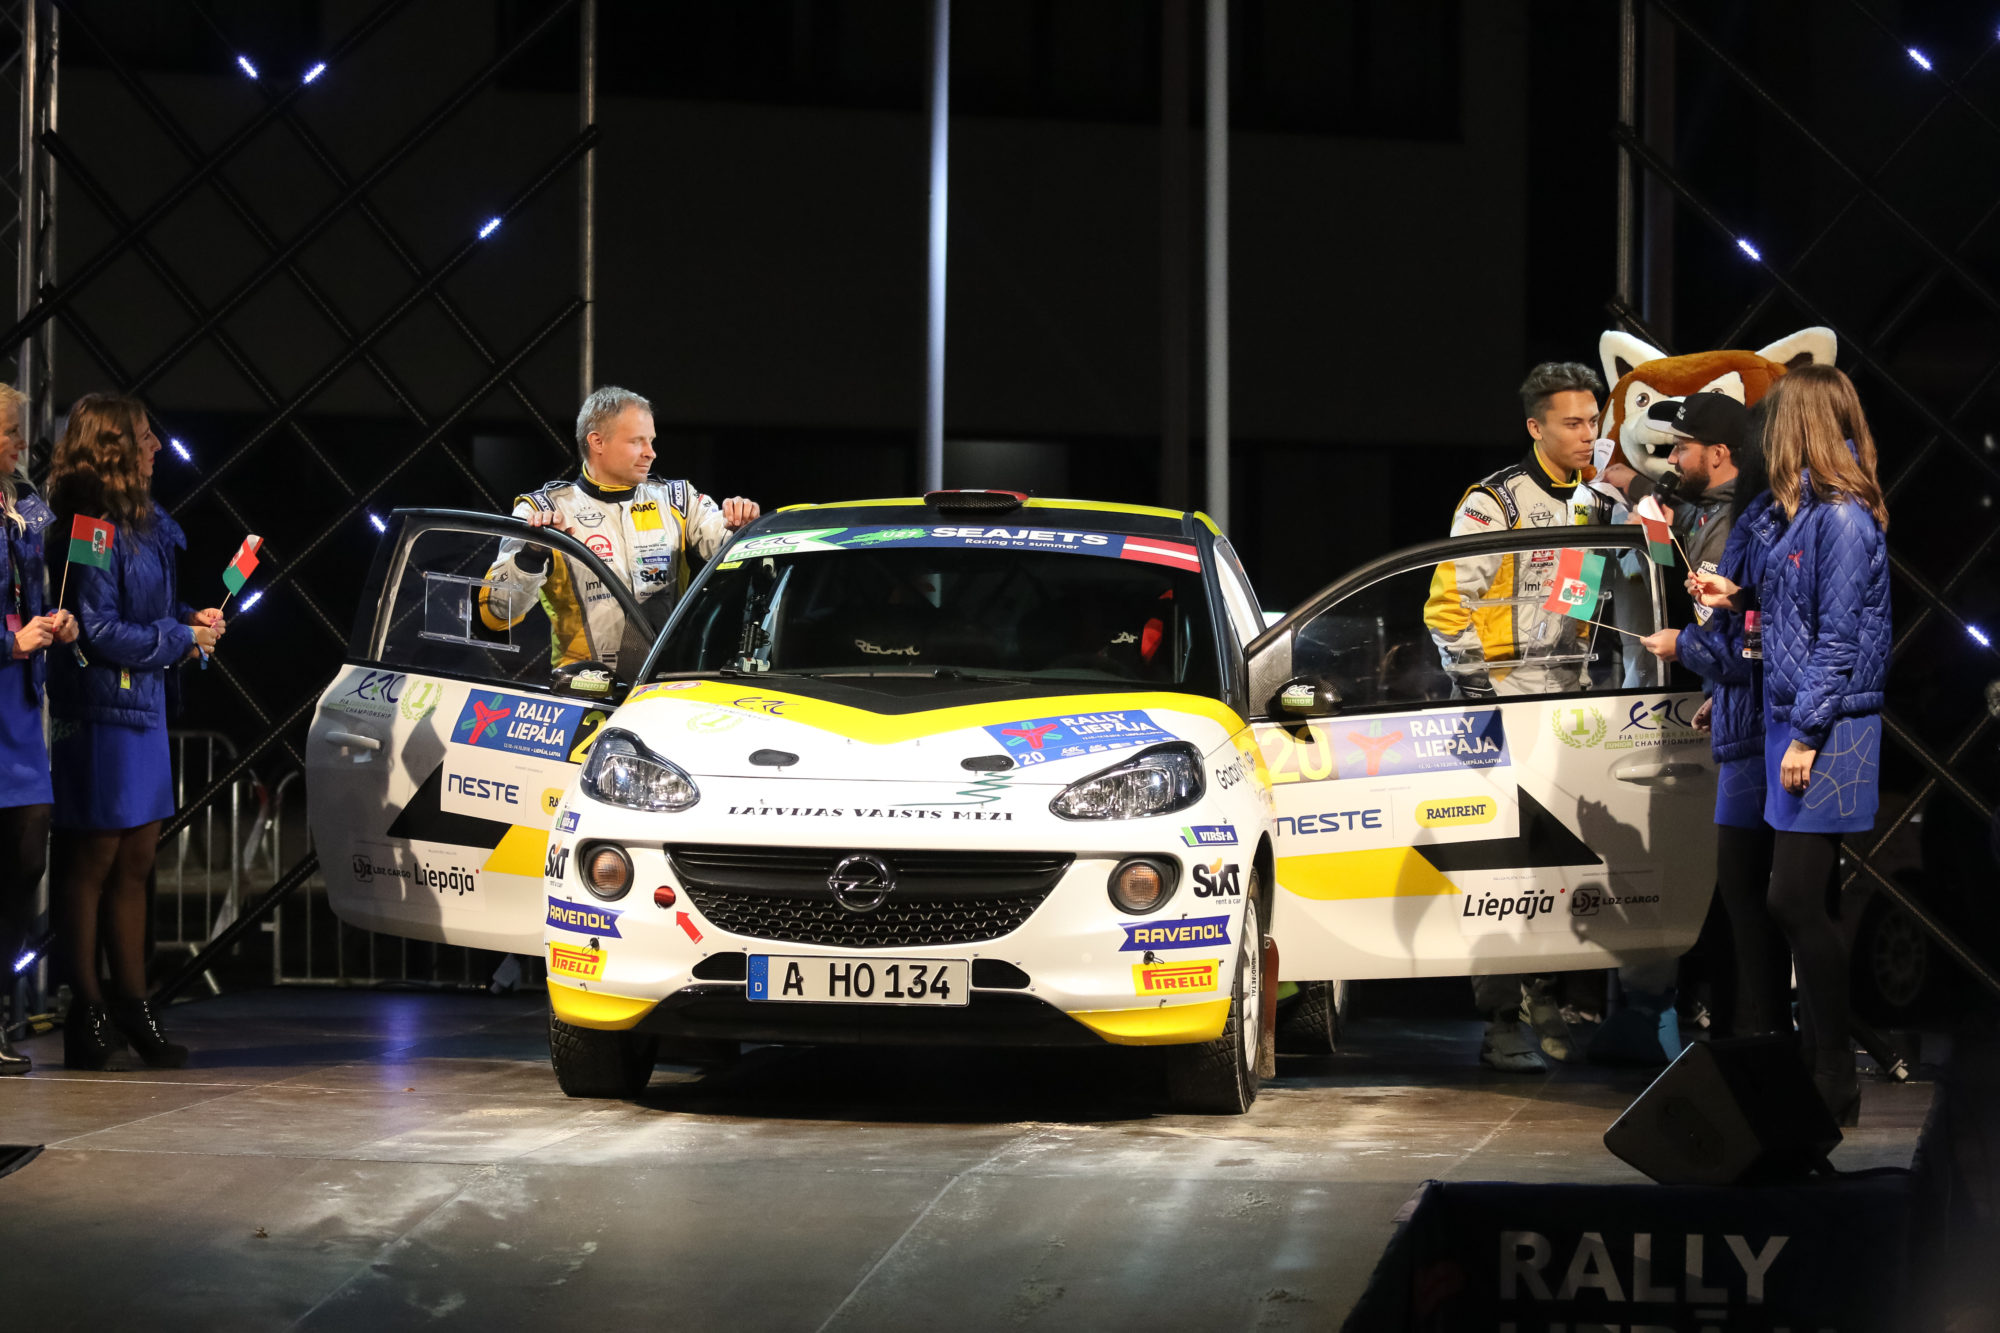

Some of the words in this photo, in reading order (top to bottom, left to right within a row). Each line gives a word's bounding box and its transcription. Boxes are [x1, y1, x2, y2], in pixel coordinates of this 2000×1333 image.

[931, 526, 1108, 546] SEAJETS
[965, 538, 1007, 547] Racing
[1029, 541, 1079, 550] summer
[588, 593, 614, 602] SAMSU
[515, 702, 565, 724] RALLY
[1060, 713, 1126, 727] RALLY
[1570, 709, 1590, 735] 1
[506, 721, 565, 746] LIEPĀJA
[1071, 722, 1157, 735] LIEPĀJA
[1410, 717, 1475, 738] RALLY
[1261, 724, 1333, 784] 20
[1415, 735, 1499, 758] LIEPĀJA
[1019, 751, 1046, 766] 20
[728, 806, 844, 817] LATVIJAS
[853, 808, 942, 819] VALSTS
[1426, 804, 1487, 819] RAMIRENT
[414, 863, 475, 895] Liepāja
[1463, 889, 1555, 921] Liepāja
[1625, 895, 1659, 904] CARGO
[550, 905, 611, 930] RAVENOL
[1134, 924, 1223, 943] RAVENOL
[552, 948, 599, 975] PIRELLI
[754, 982, 762, 992] D
[782, 962, 803, 996] A
[1142, 965, 1212, 990] PIRELLI
[1499, 1230, 1790, 1303] RALLY
